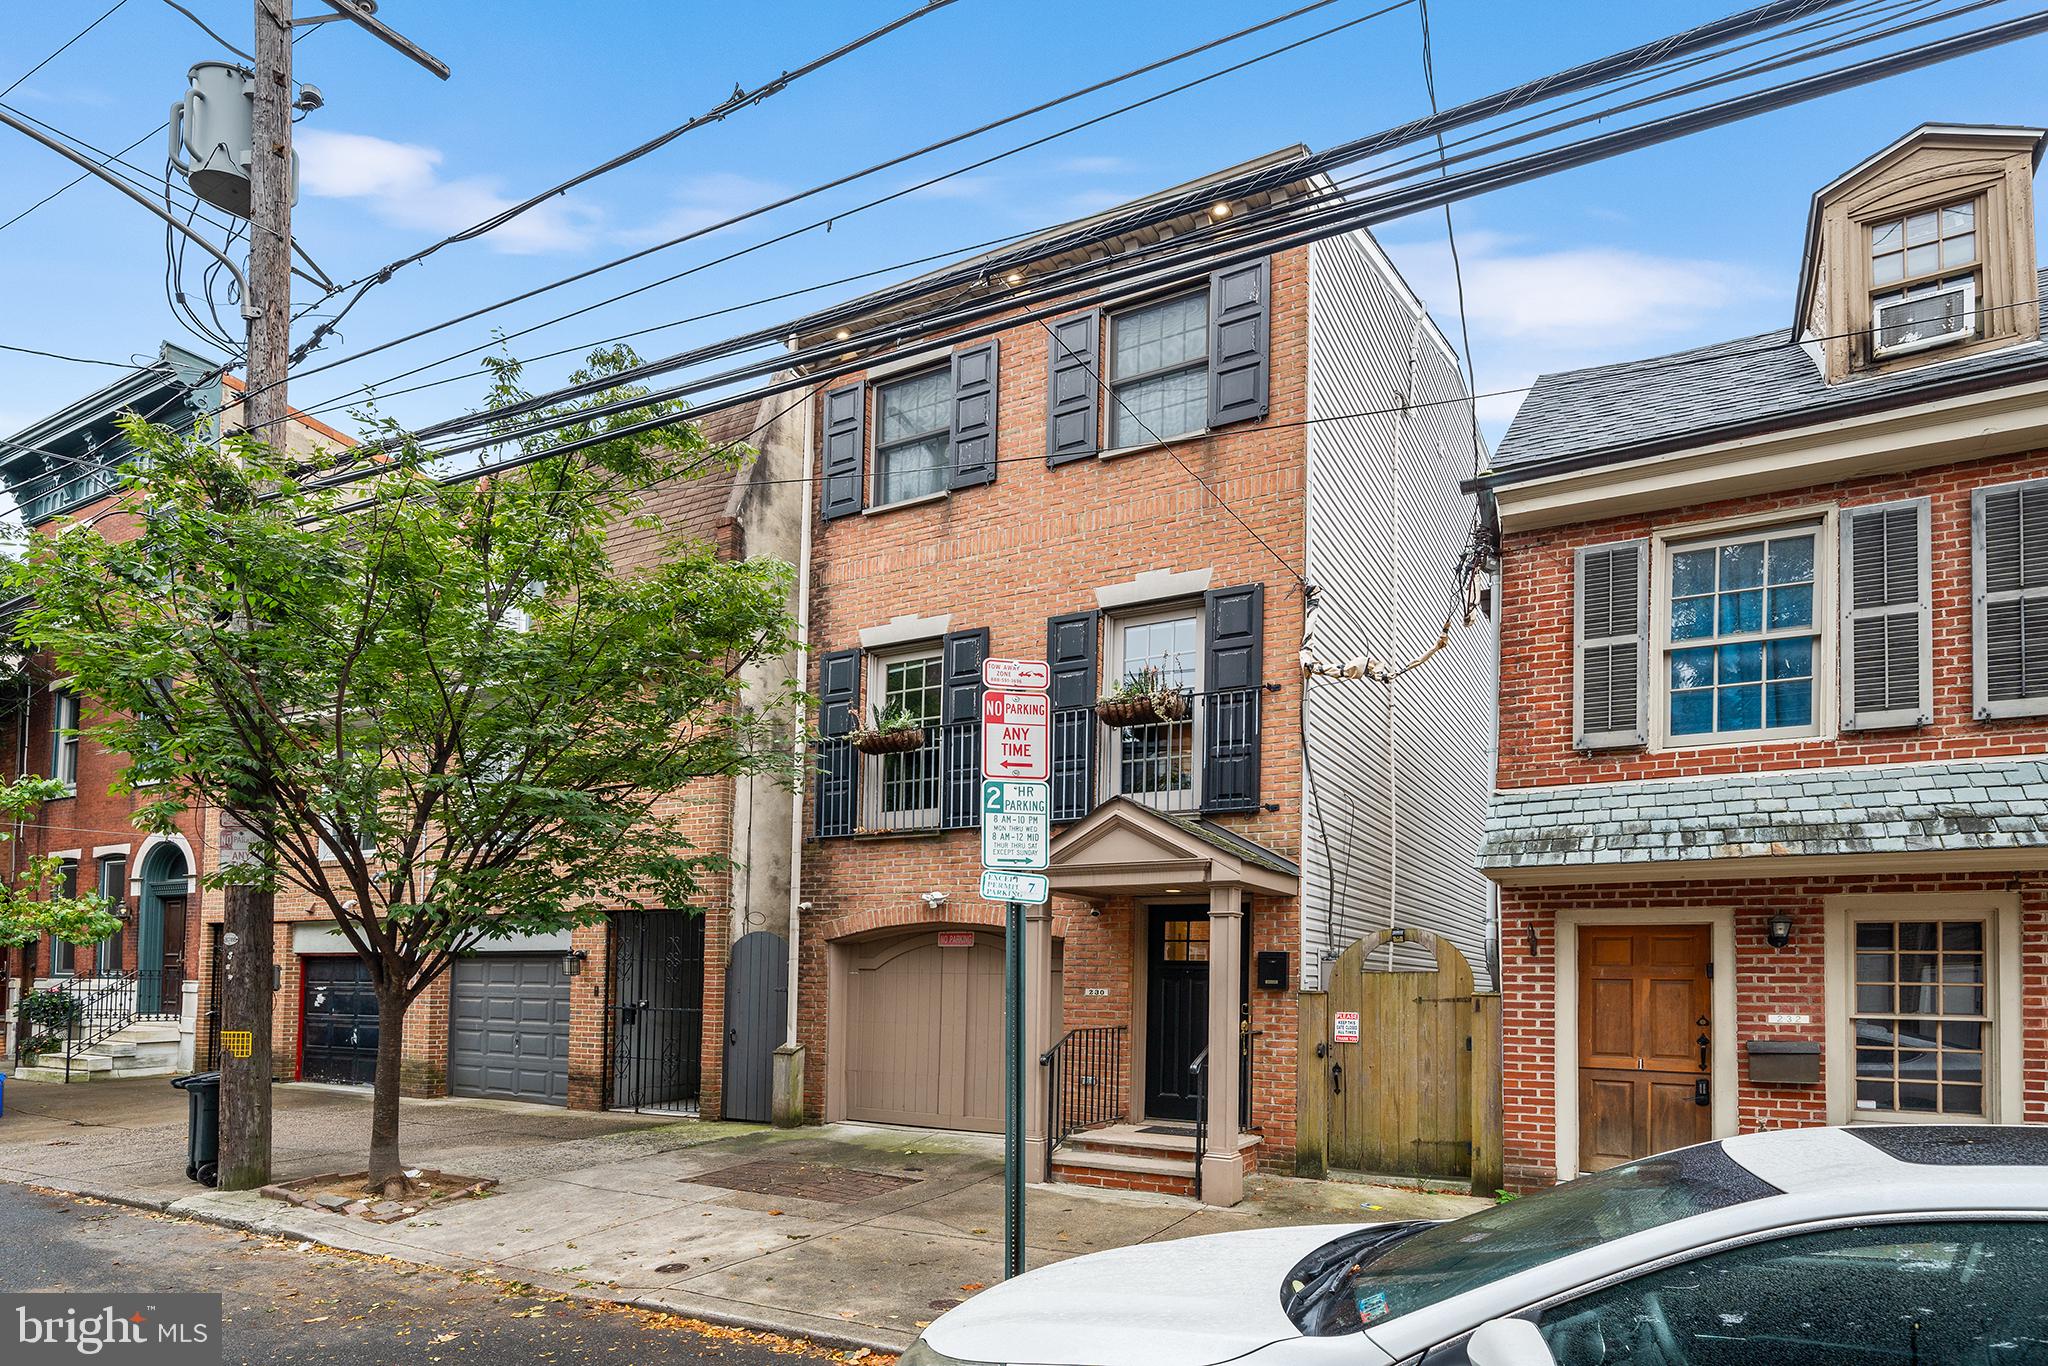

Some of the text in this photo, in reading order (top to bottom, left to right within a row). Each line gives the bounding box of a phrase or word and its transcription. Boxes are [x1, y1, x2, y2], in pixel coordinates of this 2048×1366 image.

[986, 700, 1045, 716] NO PARKING
[1003, 727, 1030, 741] ANY
[1001, 743, 1031, 757] TIME
[986, 786, 1034, 809] 2 HR
[1005, 800, 1045, 812] PARKING
[993, 815, 999, 823] 8
[1028, 816, 1038, 825] PM
[992, 832, 997, 840] 8
[232, 851, 250, 860] ANY
[987, 881, 1019, 890] PERMIT
[1028, 883, 1036, 893] 7
[986, 888, 1023, 898] PARKING
